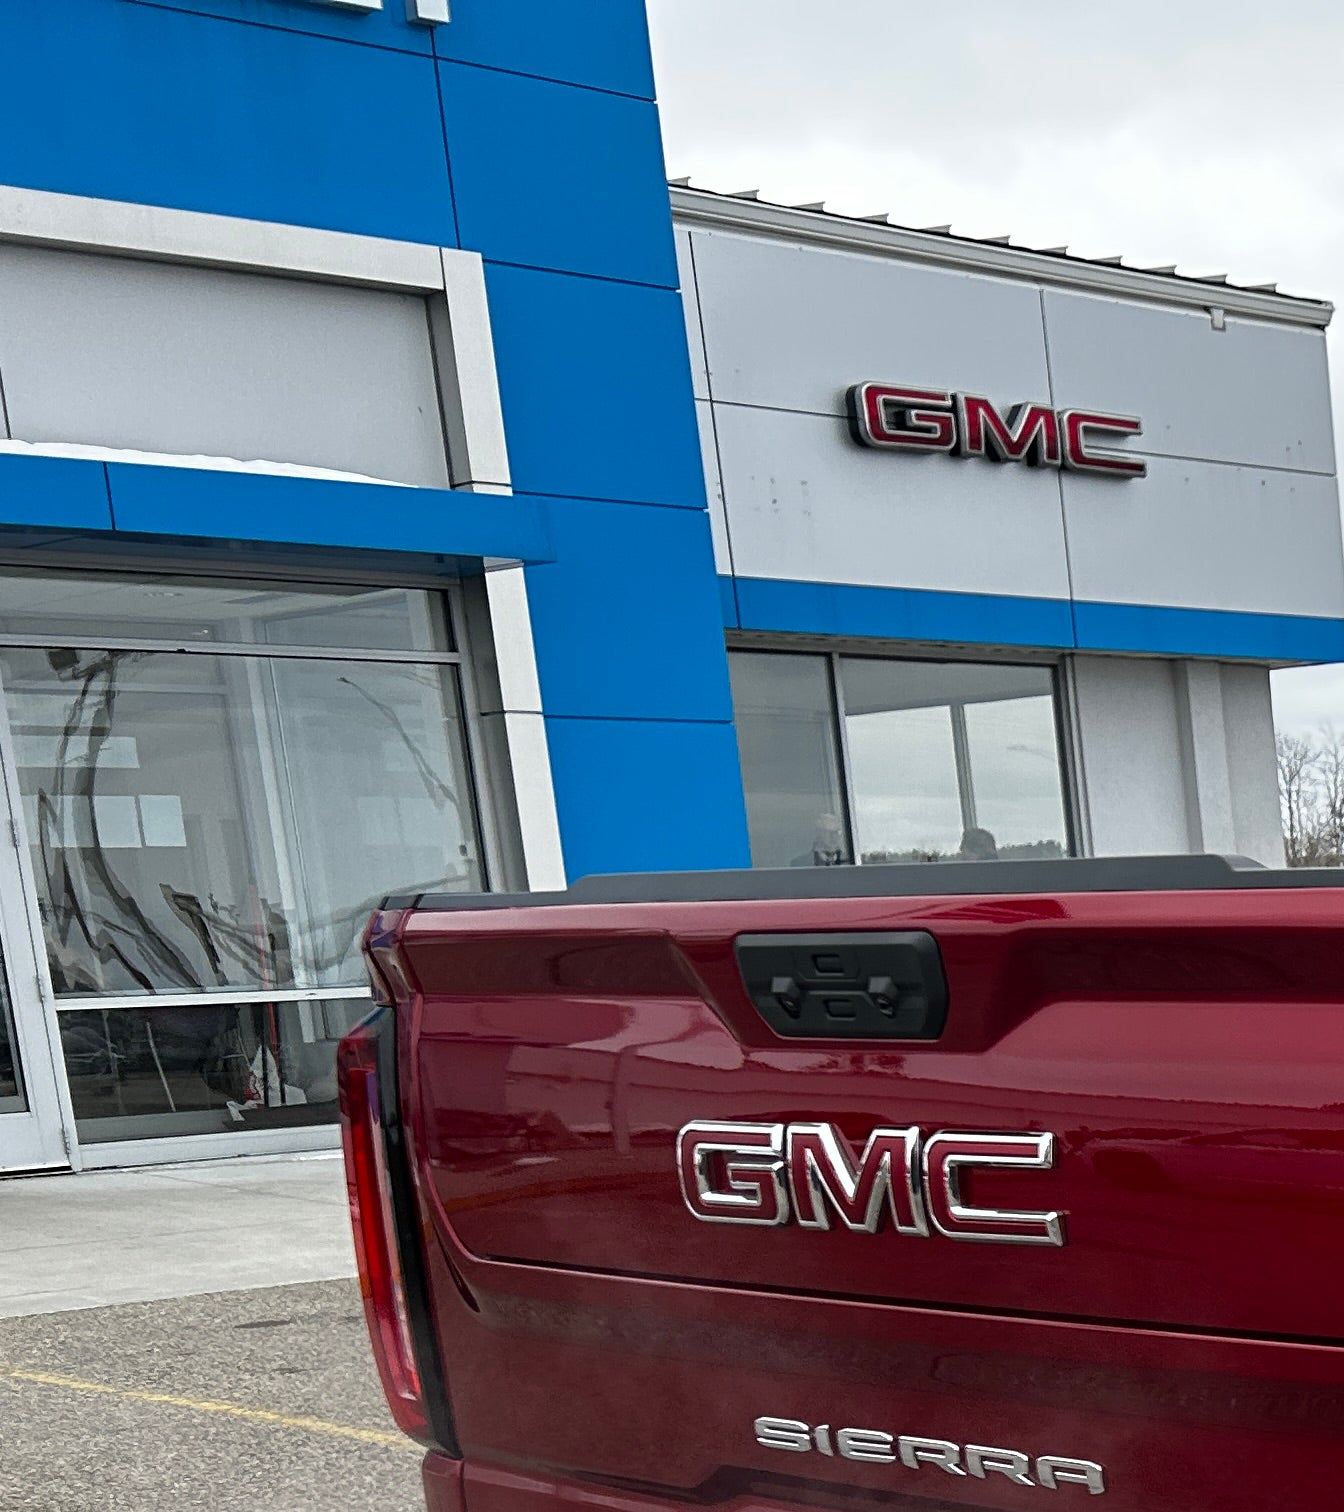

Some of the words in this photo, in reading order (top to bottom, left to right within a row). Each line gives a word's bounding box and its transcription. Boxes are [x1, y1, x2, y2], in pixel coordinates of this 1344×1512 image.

[848, 381, 1147, 478] GMC
[676, 1119, 1065, 1247] GMC
[753, 1416, 1106, 1495] SIERRA
